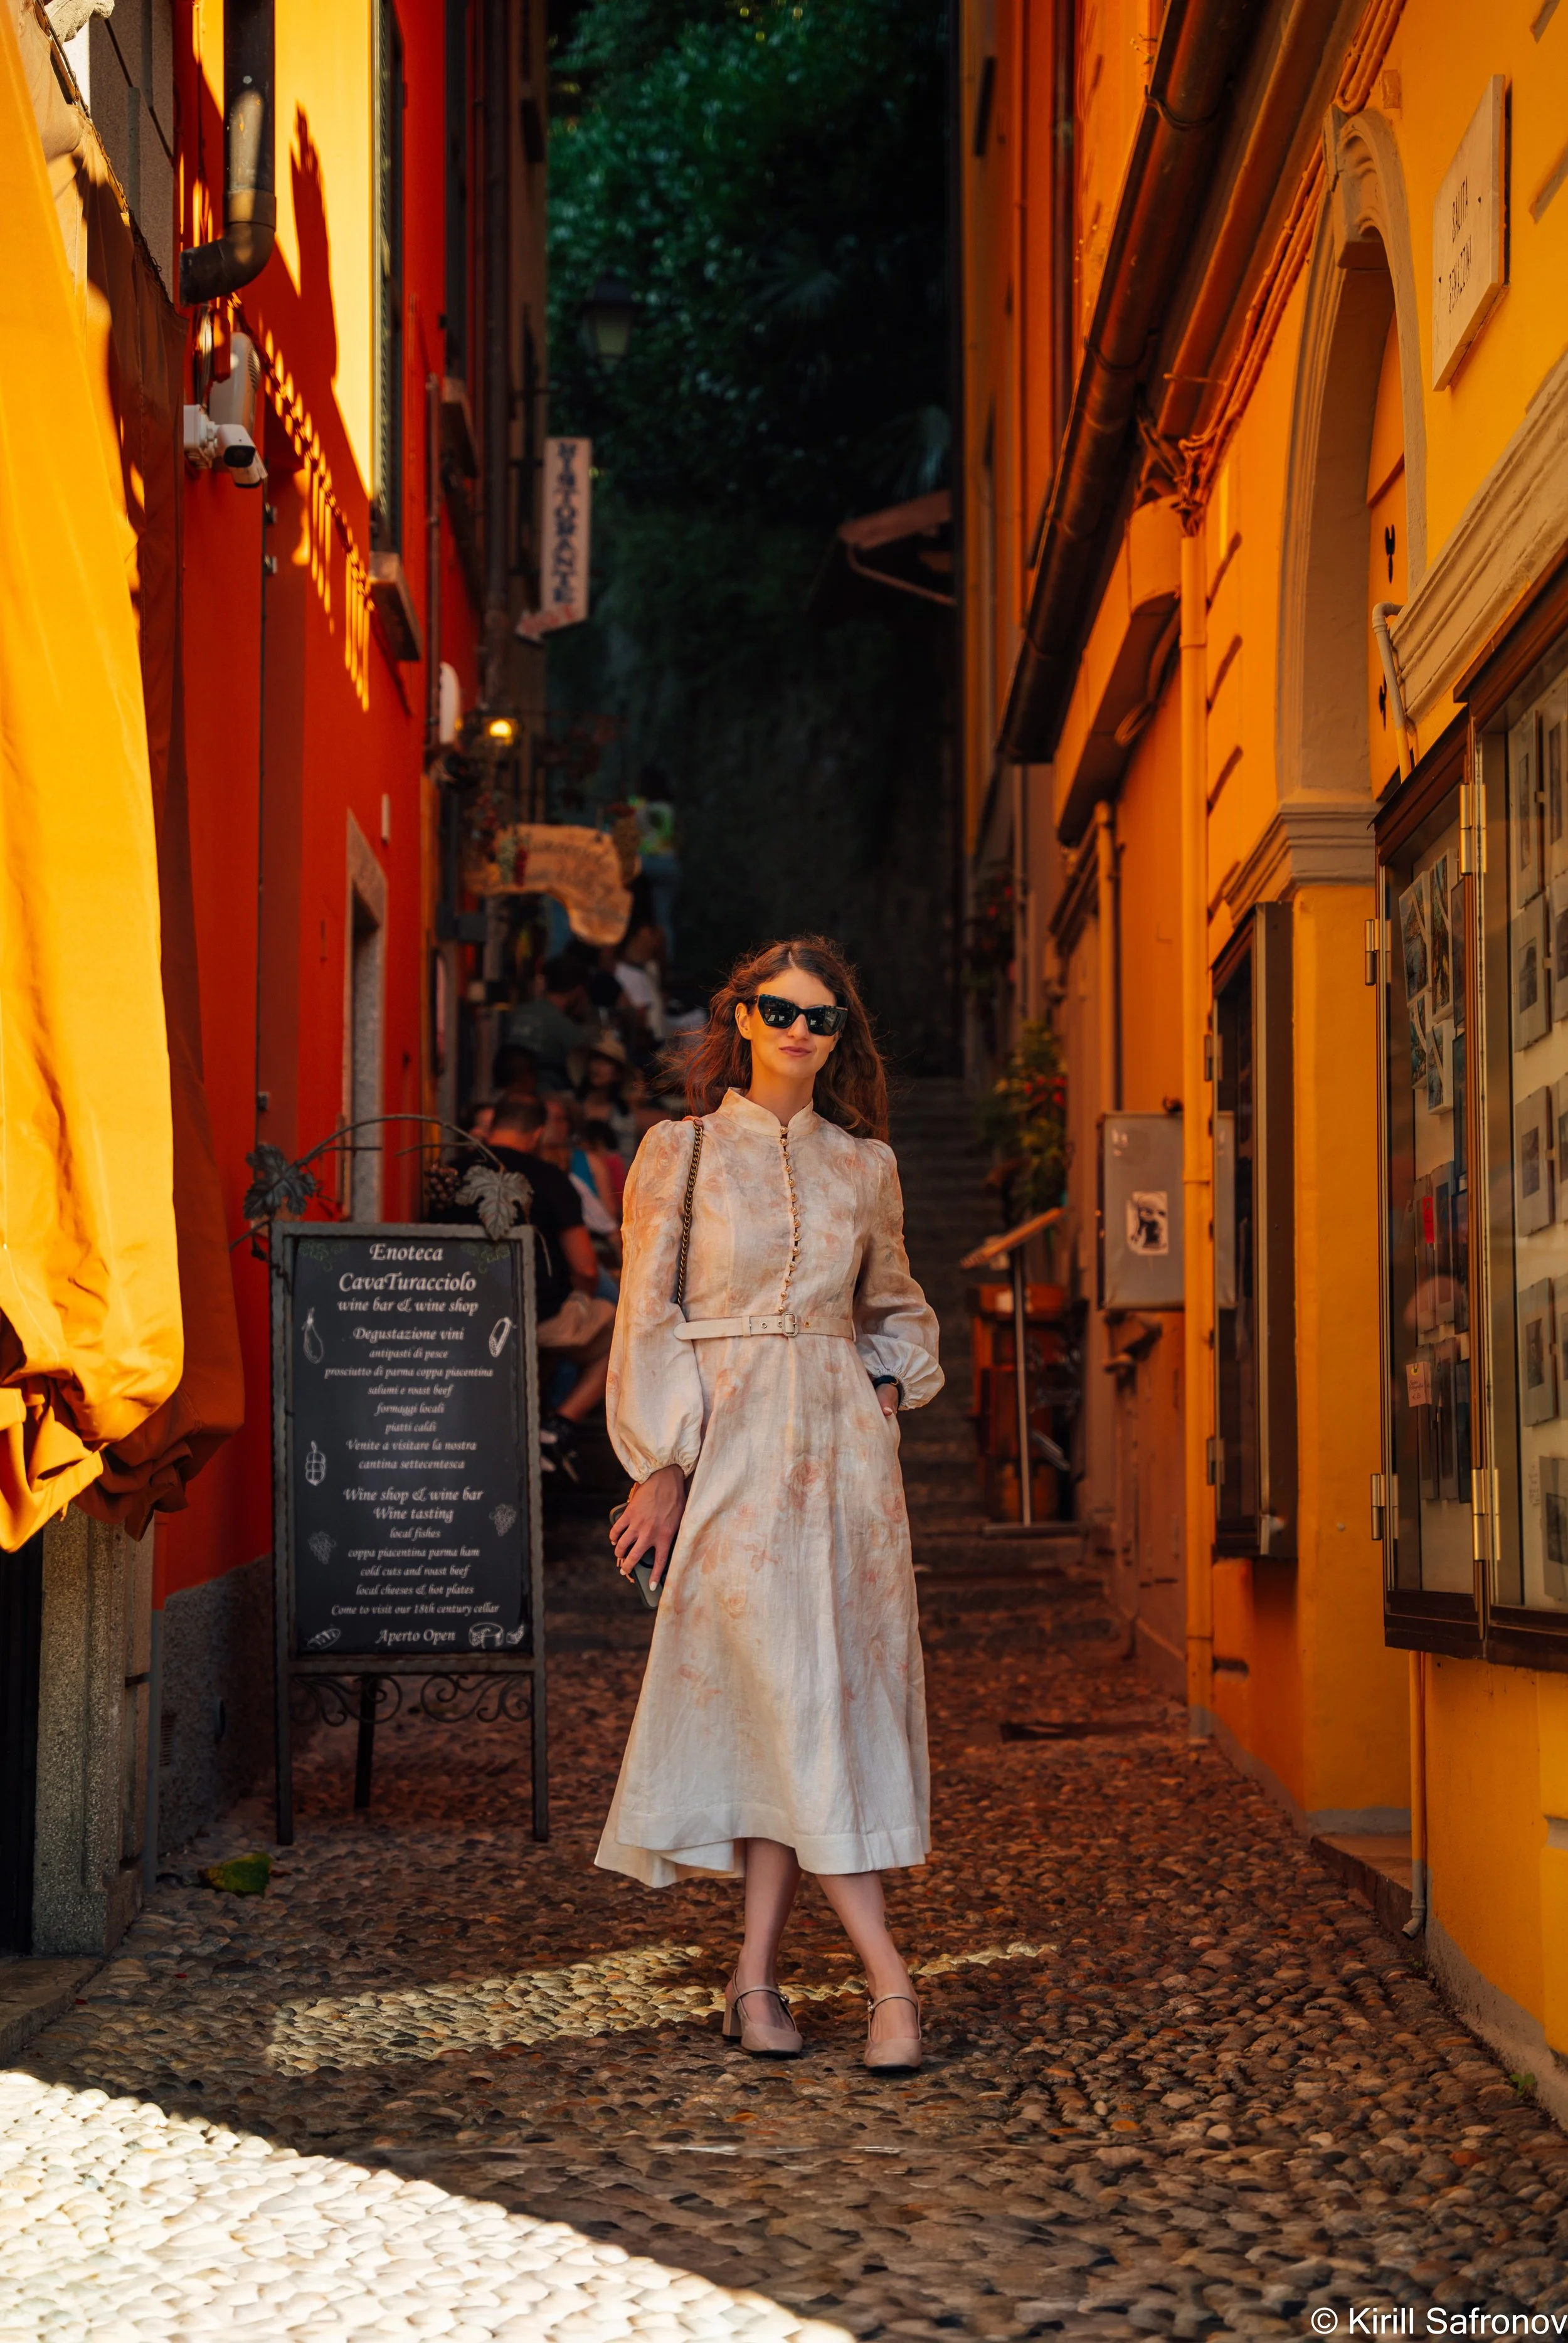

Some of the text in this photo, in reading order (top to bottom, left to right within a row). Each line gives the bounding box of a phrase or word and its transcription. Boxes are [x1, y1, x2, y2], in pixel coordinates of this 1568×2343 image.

[1452, 174, 1468, 243] SALITA
[369, 1243, 443, 1261] Enoteca
[339, 1271, 476, 1291] CavaTuracciolo
[337, 1296, 479, 1316] wine bar & wine shop
[352, 1326, 464, 1343] Degustazione vini
[369, 1347, 448, 1360] antipasti di pesce
[324, 1365, 493, 1378] prosciutto di parma coppa piacentina
[368, 1383, 398, 1394] salumi
[408, 1385, 430, 1394] roast
[433, 1383, 453, 1397] beef
[374, 1401, 444, 1415] formaggi locali
[385, 1421, 437, 1434] piatti caldi
[346, 1438, 379, 1450] Venite
[391, 1439, 430, 1450] visitare
[432, 1438, 442, 1450] la
[444, 1441, 477, 1450] nostra
[359, 1458, 465, 1469] cantina settecentesca
[343, 1485, 484, 1504] Wine shop & wine bar
[373, 1506, 453, 1523] Wine tasting
[389, 1526, 440, 1541] local fishes
[347, 1545, 479, 1560] coppa piacentina parma ham
[361, 1565, 381, 1575] cold
[403, 1565, 422, 1575] and
[424, 1567, 447, 1575] roast
[449, 1565, 470, 1578] beef
[356, 1583, 474, 1597] local cheeses & hot plates
[331, 1604, 356, 1615] Come
[359, 1605, 369, 1614] to
[372, 1604, 391, 1614] visit
[414, 1602, 435, 1614] 18th
[437, 1604, 470, 1616] century
[473, 1601, 500, 1612] cellar
[375, 1629, 455, 1645] Aperto Open
